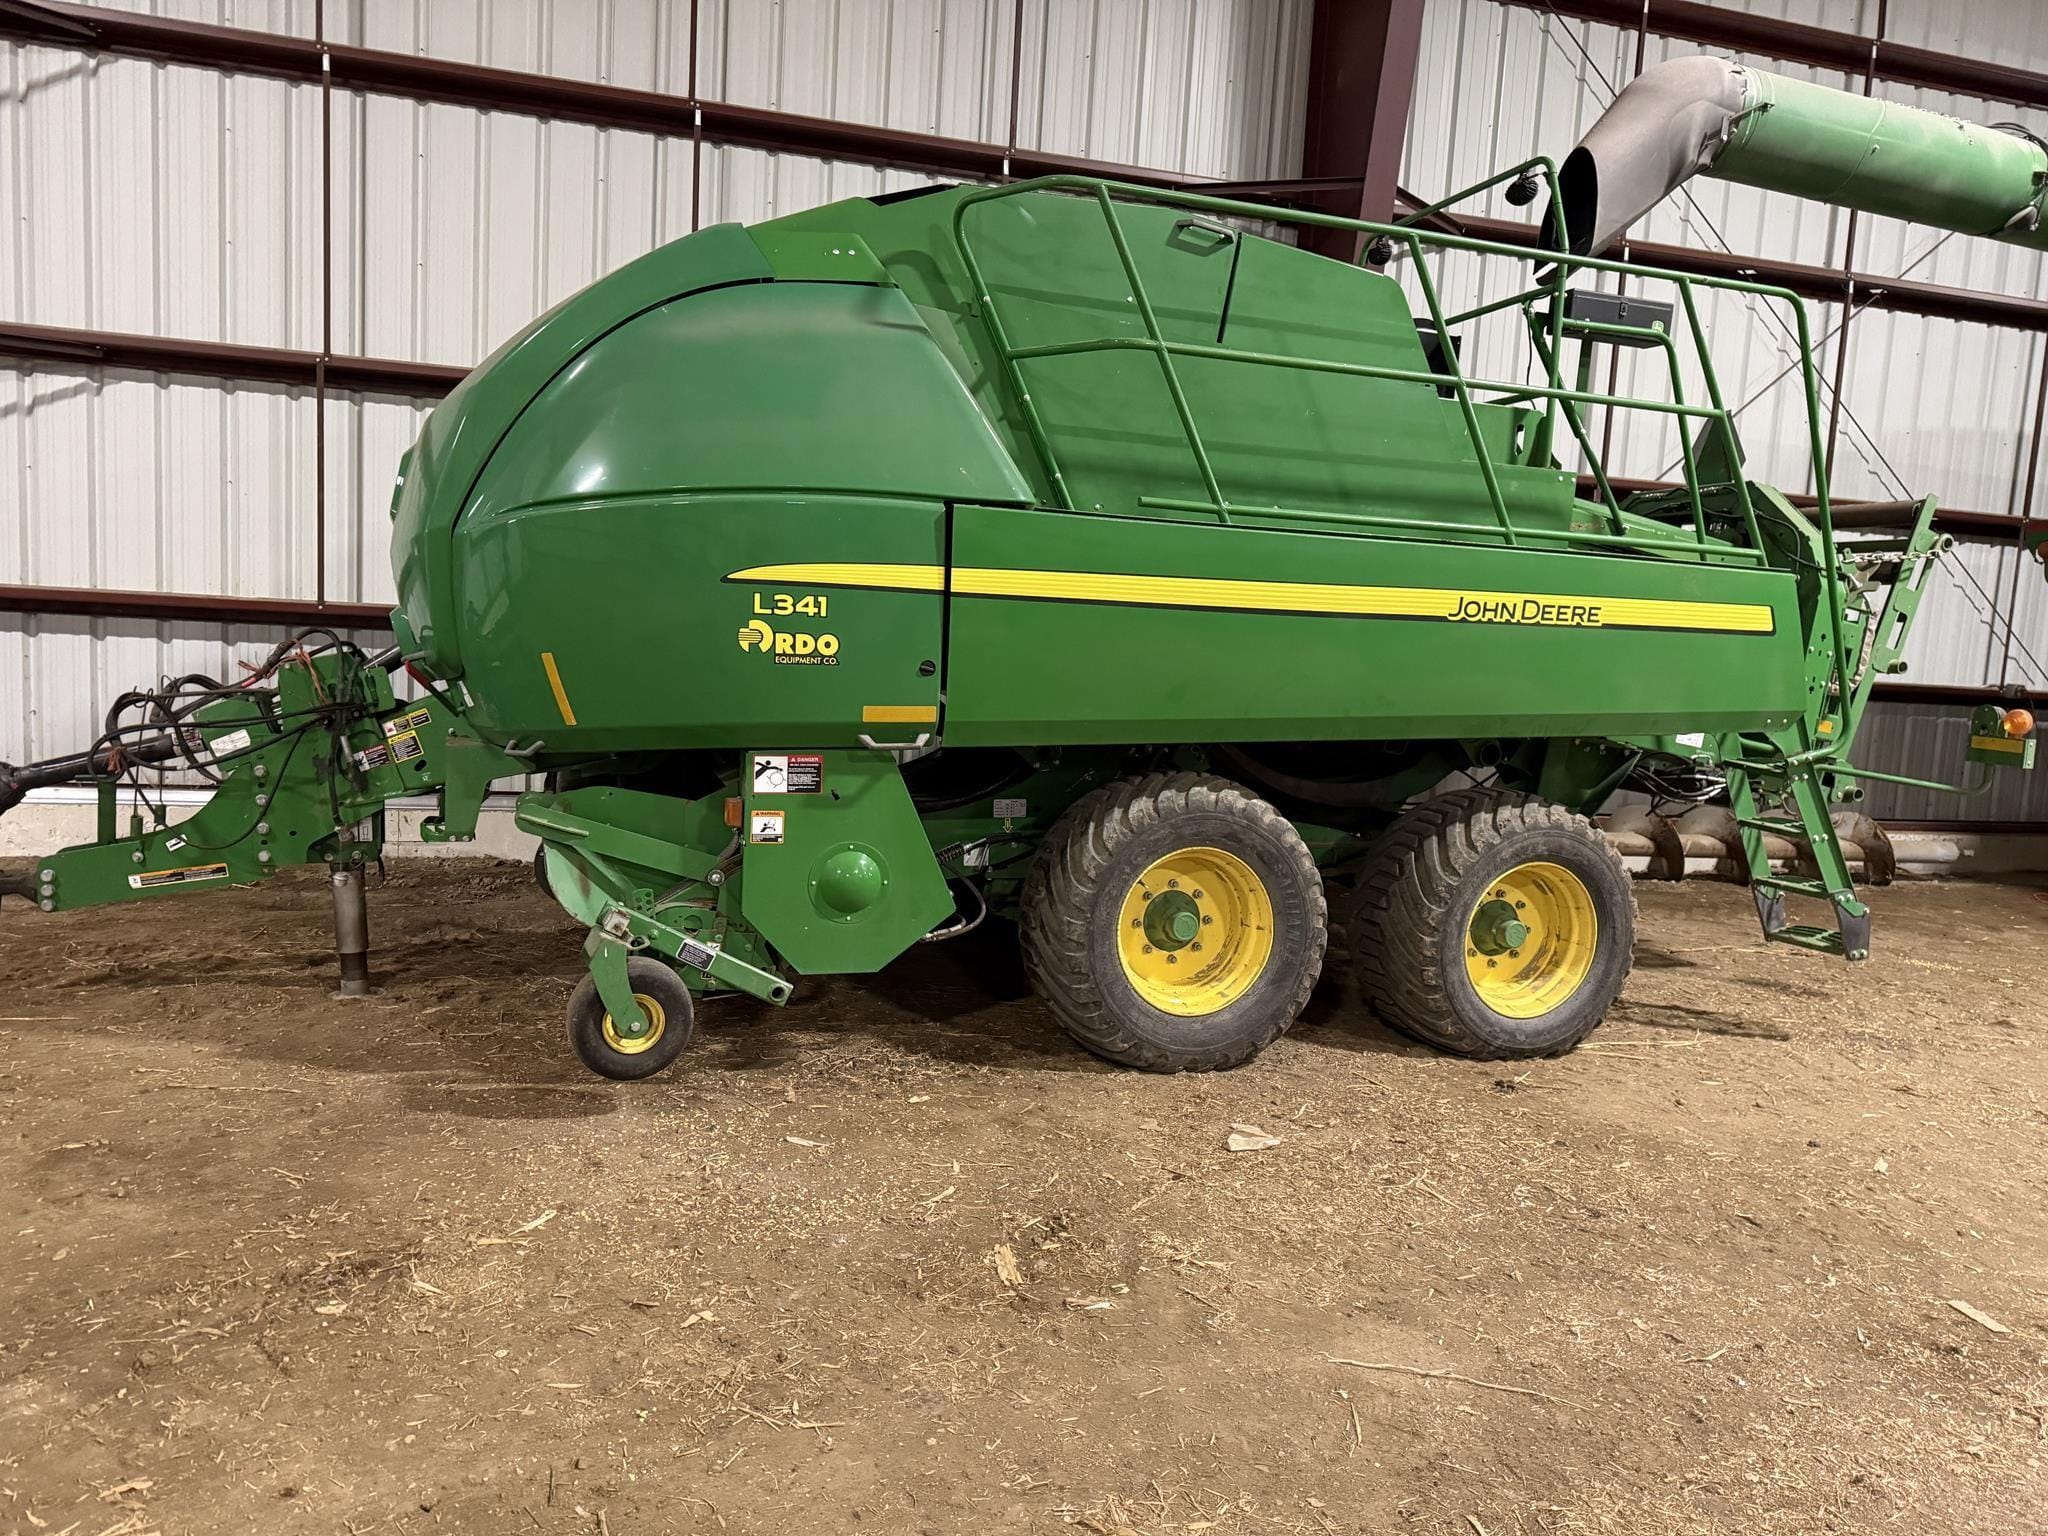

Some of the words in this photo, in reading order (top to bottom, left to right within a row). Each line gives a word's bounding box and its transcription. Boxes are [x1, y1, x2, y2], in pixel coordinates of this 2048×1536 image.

[753, 592, 828, 618] L341
[1447, 596, 1517, 620] JOHN
[1520, 599, 1603, 624] DEERE
[774, 632, 840, 658] RDO
[775, 656, 821, 665] EQUIPMENT
[823, 656, 839, 666] CO.
